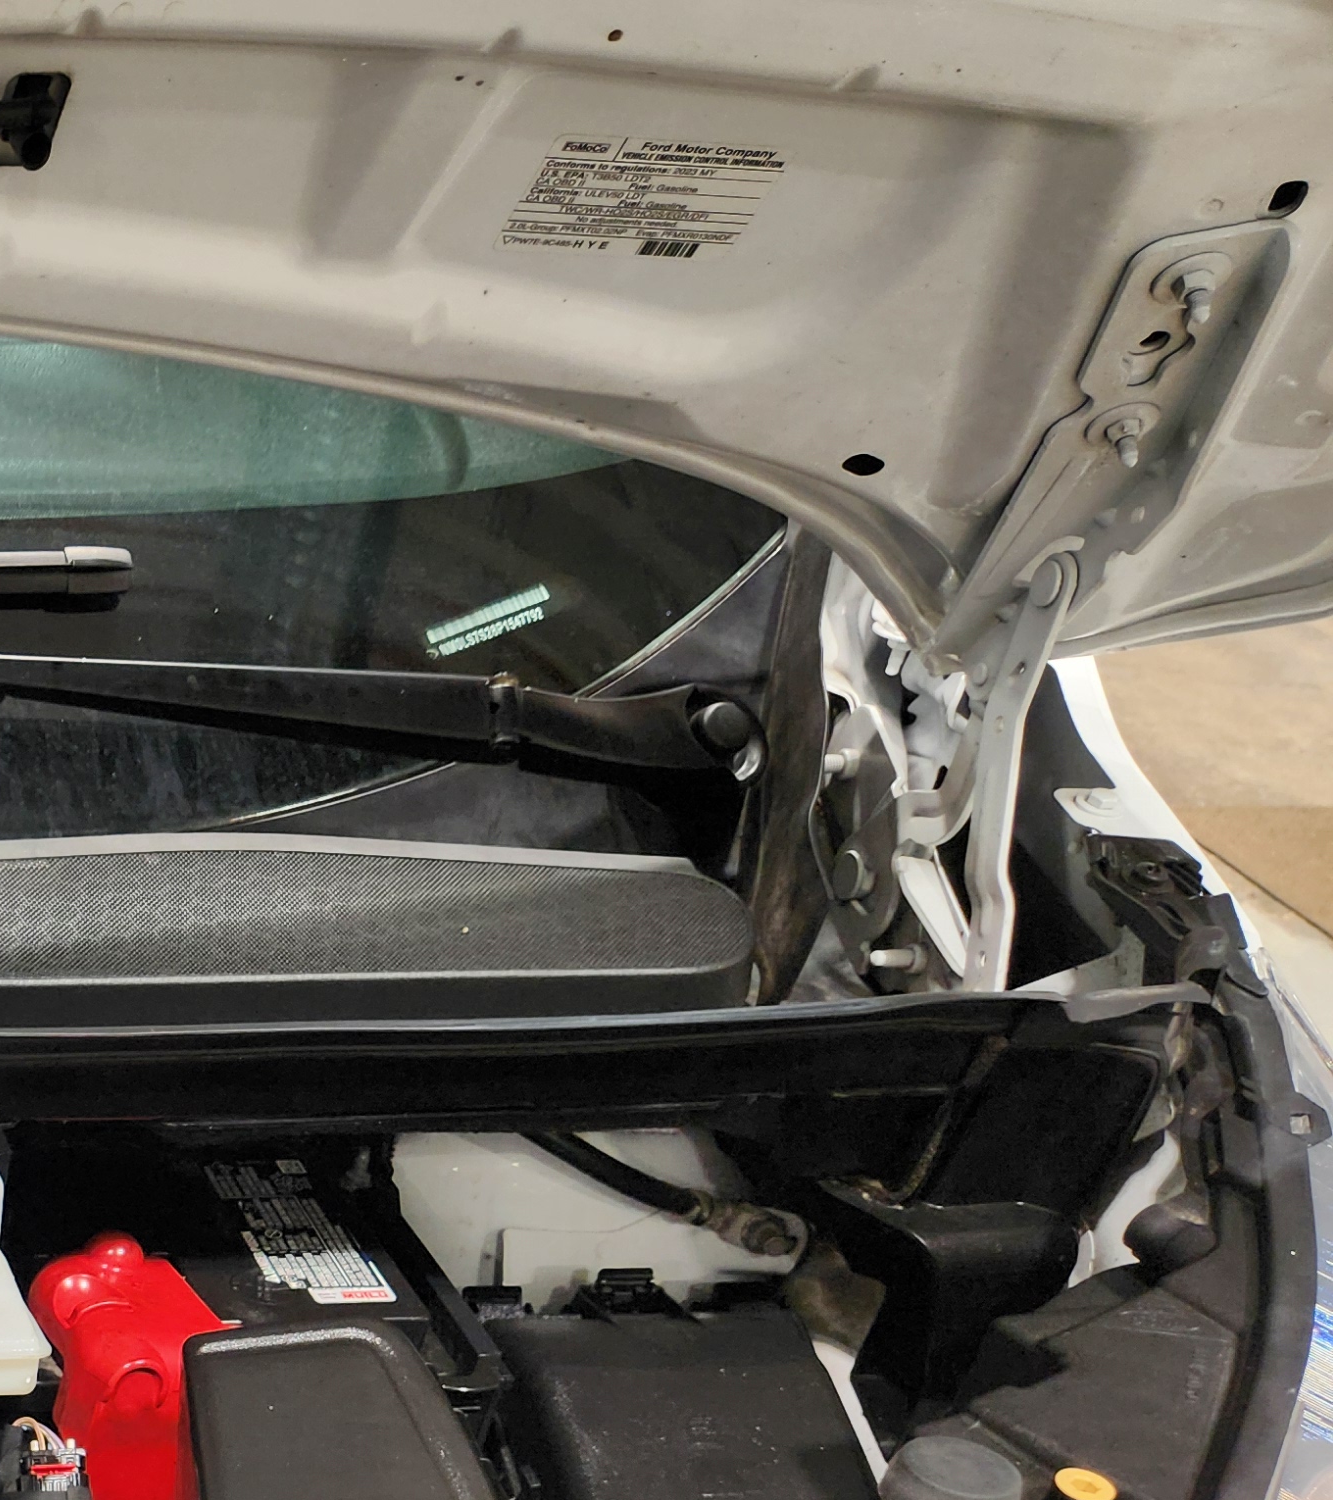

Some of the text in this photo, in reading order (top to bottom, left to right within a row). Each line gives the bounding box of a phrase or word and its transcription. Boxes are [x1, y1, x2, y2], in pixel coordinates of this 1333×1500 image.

[563, 142, 608, 152] FoMoCo
[642, 142, 777, 159] Ford Motor Company
[546, 160, 595, 171] Conforms
[597, 164, 608, 172] to
[610, 164, 671, 175] regulations:
[673, 167, 697, 176] 2023
[622, 152, 785, 168] VEHICLE EMISSION CONTROL INFORMATION
[541, 170, 562, 179] U.S.
[564, 171, 589, 180] EPA:
[624, 174, 650, 183] LDT2
[530, 186, 582, 197] California:
[625, 192, 646, 200] LDT
[536, 177, 553, 185] CA
[628, 182, 654, 191] Fuel:
[656, 184, 698, 193] Gasoline
[526, 194, 542, 202] CA
[617, 199, 643, 208] Fuel:
[645, 201, 687, 210] Gasoline
[590, 217, 641, 227] adjustments
